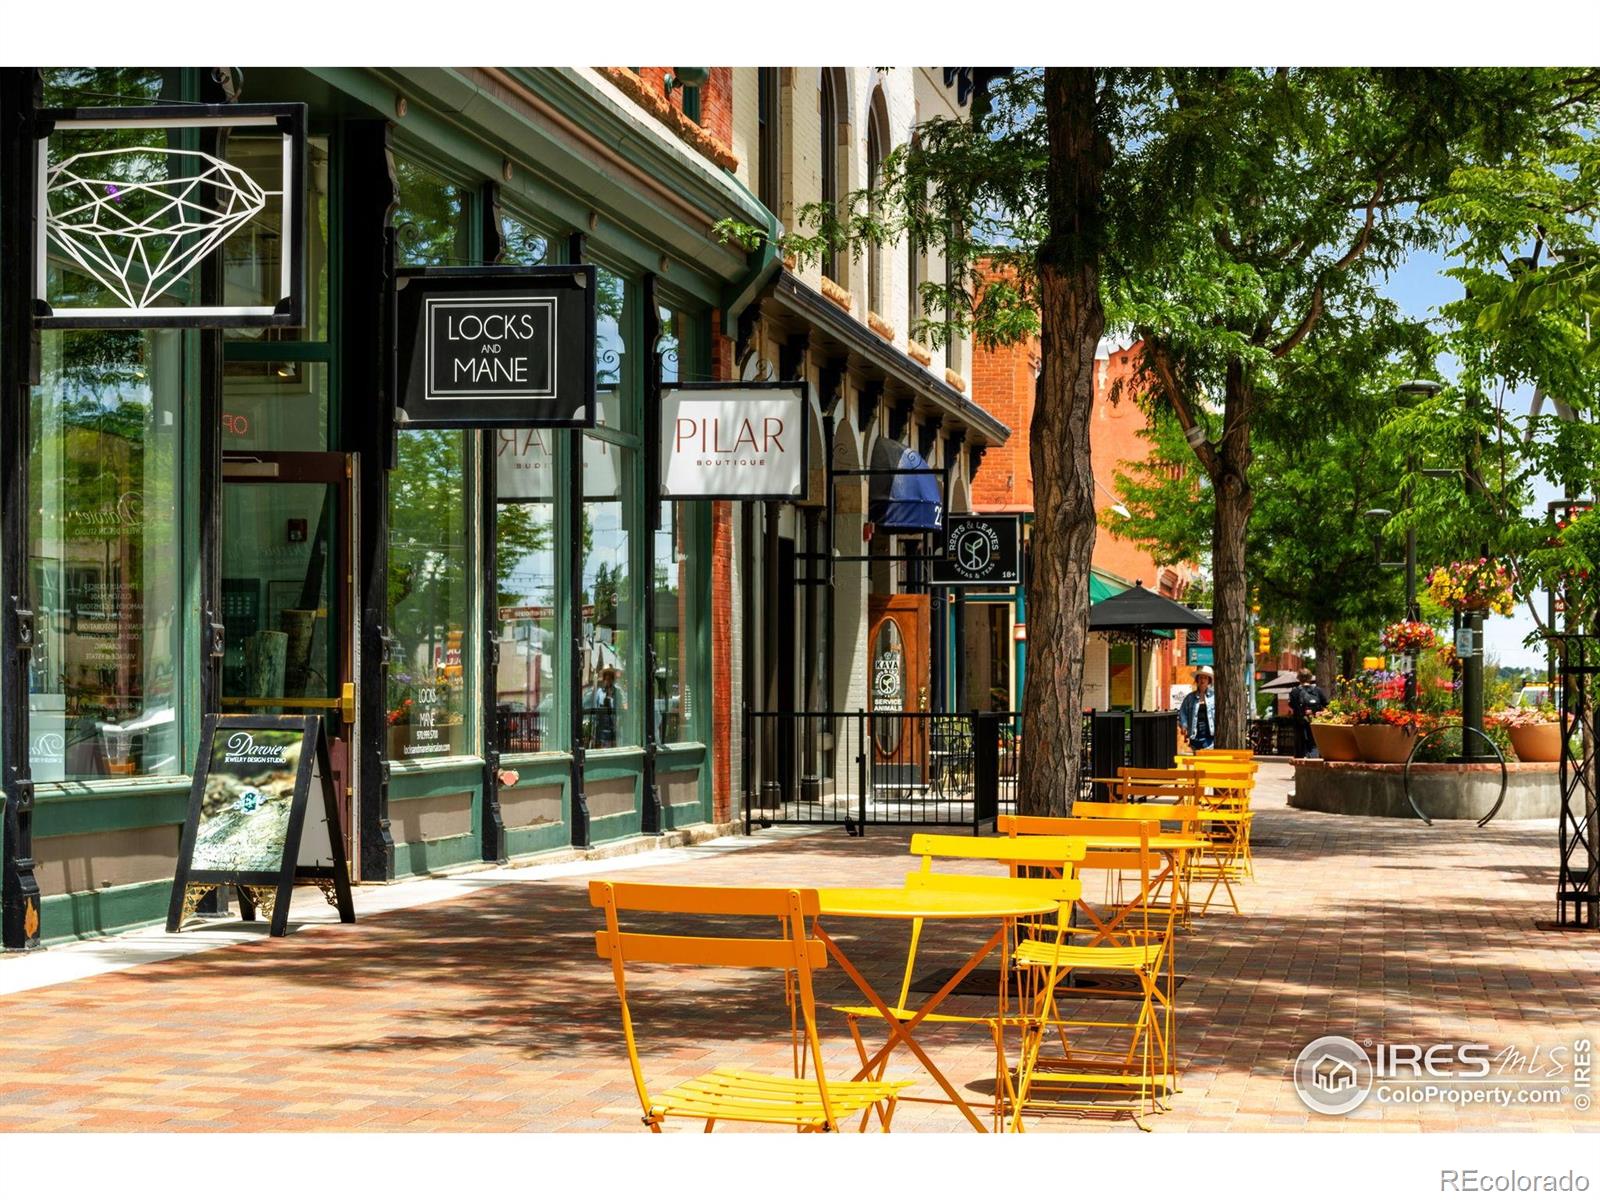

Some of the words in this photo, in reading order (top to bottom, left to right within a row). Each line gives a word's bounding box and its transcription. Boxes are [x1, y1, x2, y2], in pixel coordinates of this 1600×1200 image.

[449, 314, 534, 340] LOCKS
[481, 344, 501, 354] AND
[454, 357, 528, 383] MANE
[676, 417, 785, 453] PILAR
[934, 505, 942, 526] 2
[949, 524, 966, 551] ROOTS
[976, 522, 999, 551] LEAVES
[1002, 570, 1016, 578] 18+
[875, 660, 900, 670] KAVA
[225, 732, 289, 756] Darvier
